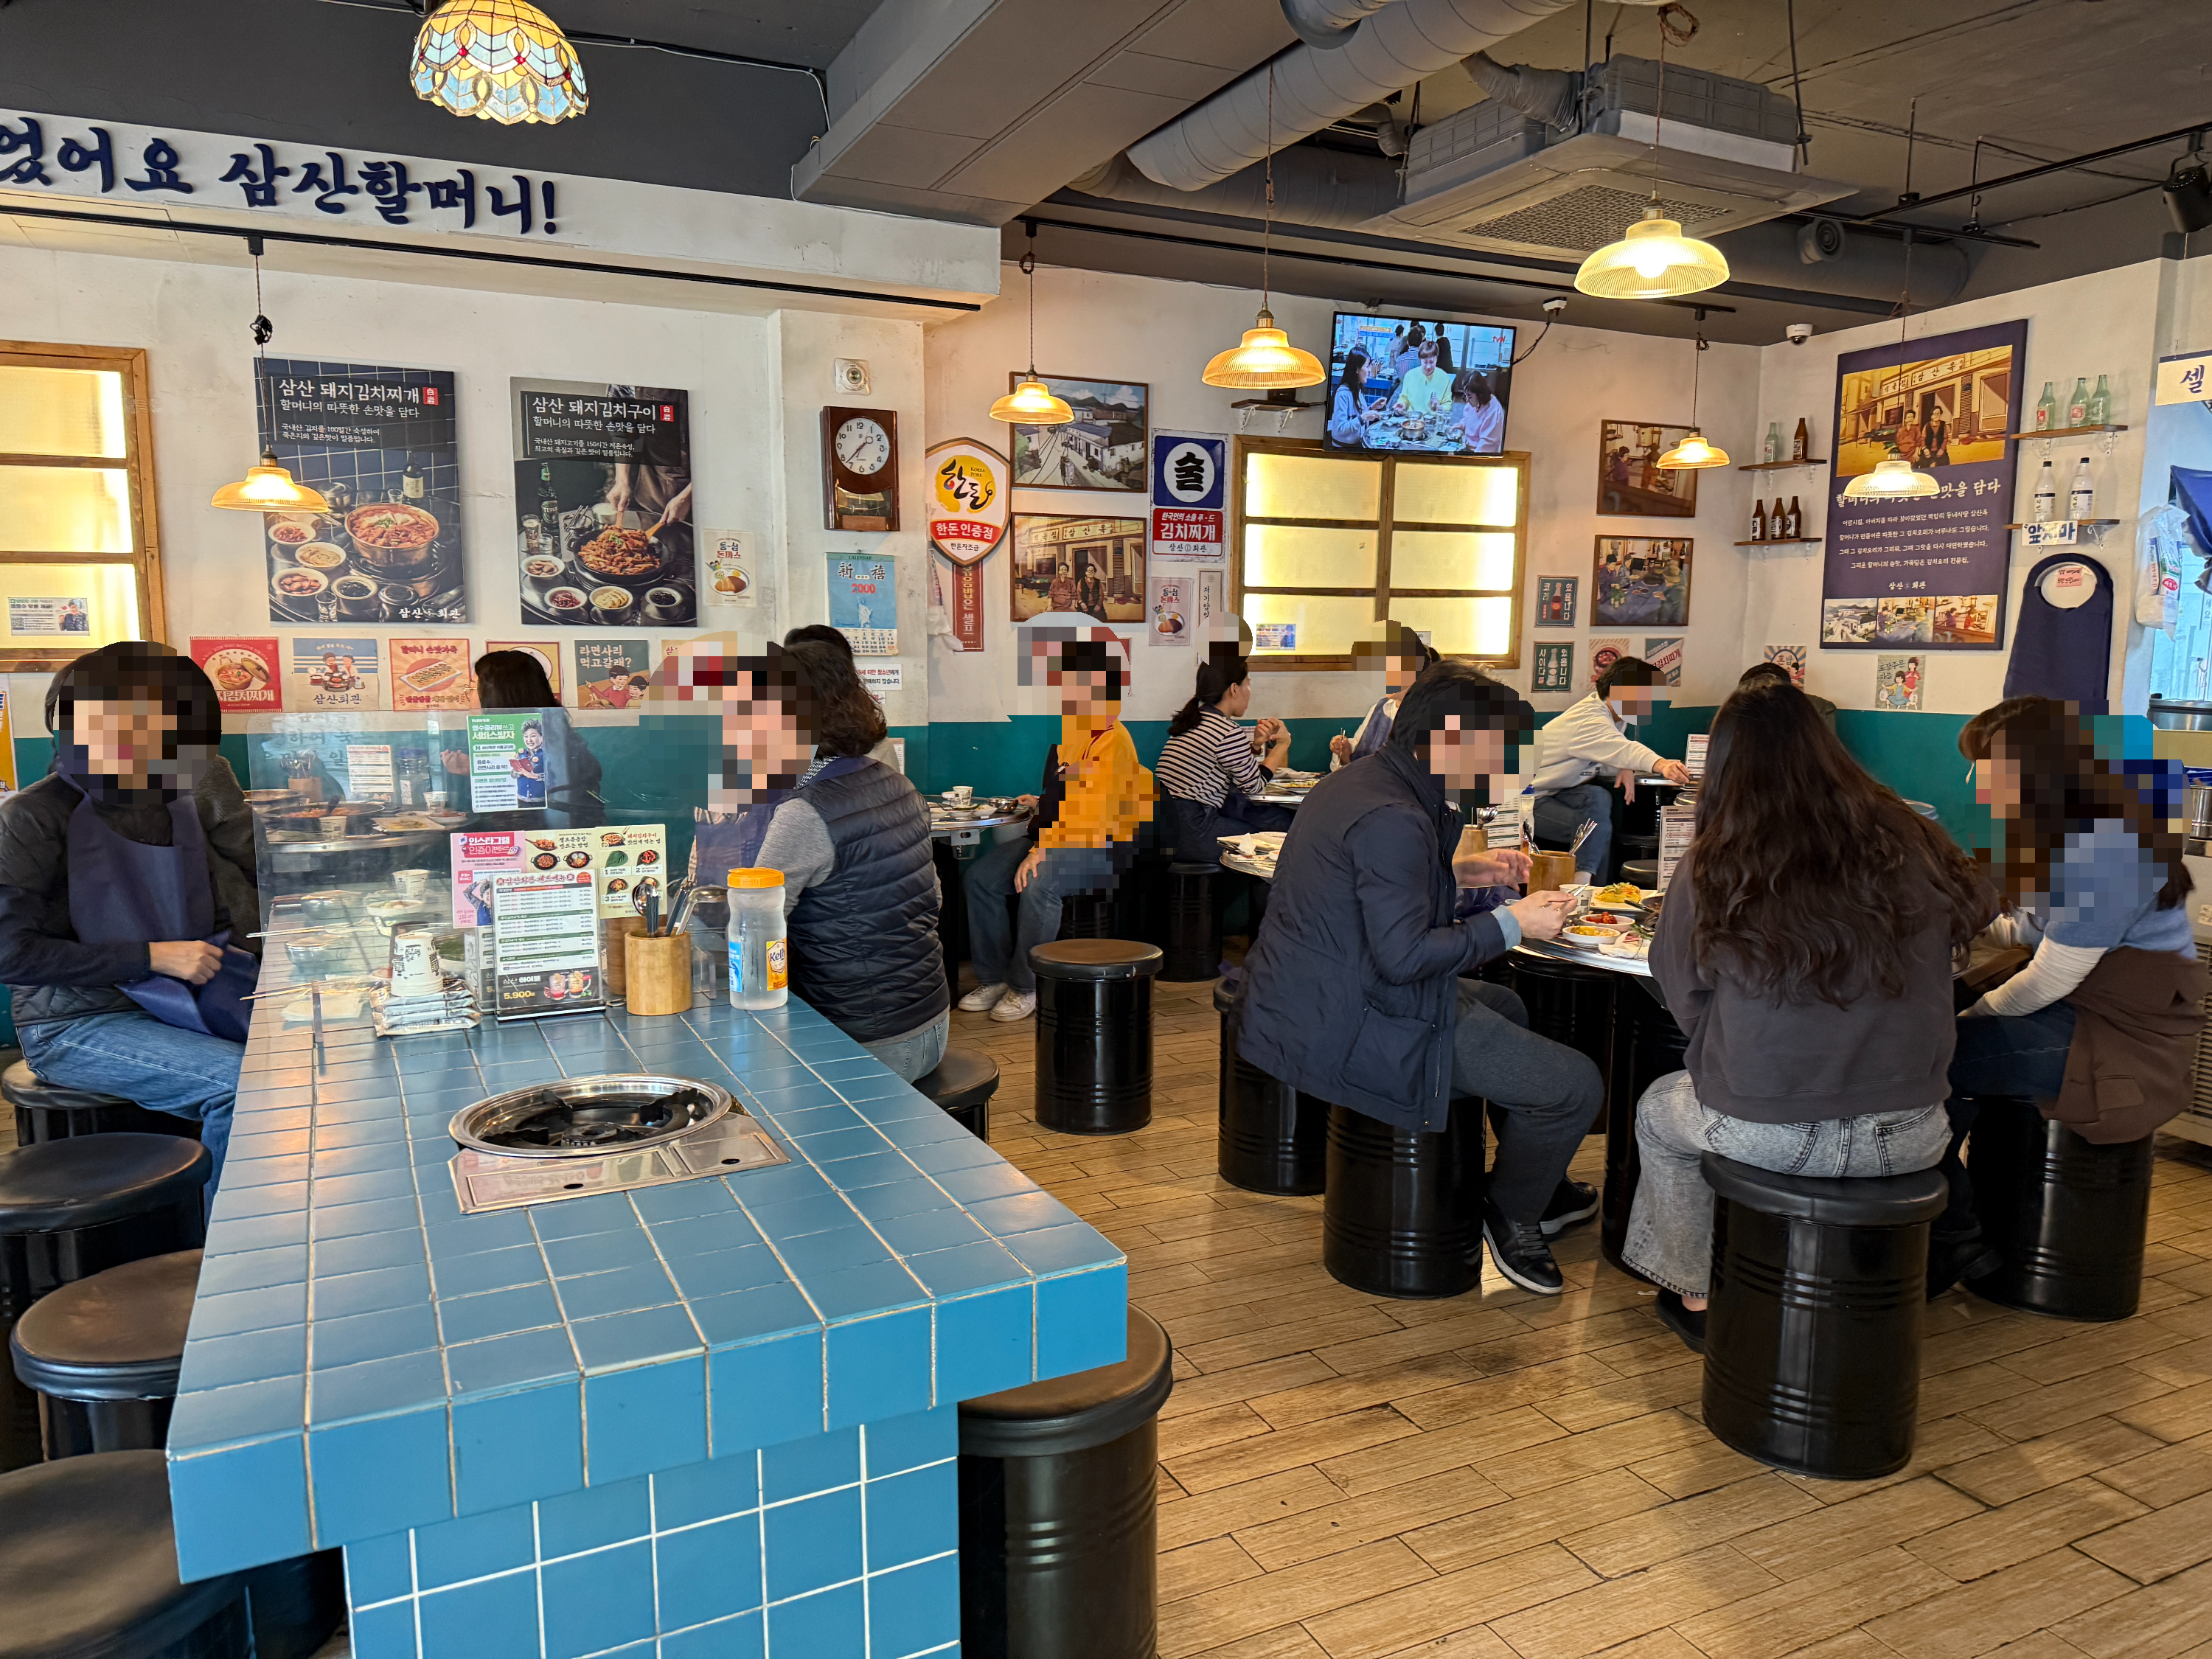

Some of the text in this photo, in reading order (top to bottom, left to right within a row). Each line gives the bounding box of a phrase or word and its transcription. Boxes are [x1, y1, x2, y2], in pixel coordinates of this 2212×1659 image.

[219, 144, 557, 234] 삼산할머니!
[2180, 365, 2205, 393] 셀
[279, 378, 420, 403] 삼산 돼지김치찌개
[279, 398, 420, 418] 할머니의 따뜻한 손맛을 담다
[532, 397, 656, 420] 삼산 돼지김치구이
[281, 423, 303, 431] 국내산
[532, 415, 655, 434] 할머니의 따뜻한 손맛을 담다
[857, 422, 863, 430] 12
[1175, 451, 1205, 492] 술
[941, 459, 993, 510] 한돈
[1973, 479, 2001, 495] 담다
[1161, 512, 1185, 521] 한국인의
[1185, 513, 1197, 521] 소울
[1161, 522, 1216, 541] 김치찌개
[950, 543, 979, 552] 한돈자조금
[852, 583, 876, 594] 2000
[1564, 583, 1573, 621] 있습니다
[398, 607, 462, 620] 삼산 회관
[963, 613, 974, 635] 셀프
[580, 645, 622, 657] 라면사리
[580, 657, 632, 669] 먹고갈래?
[1538, 649, 1546, 676] 사이다
[1559, 649, 1568, 685] 있습니다
[313, 694, 362, 704] 삼산회관
[468, 836, 510, 845] 인스타그램
